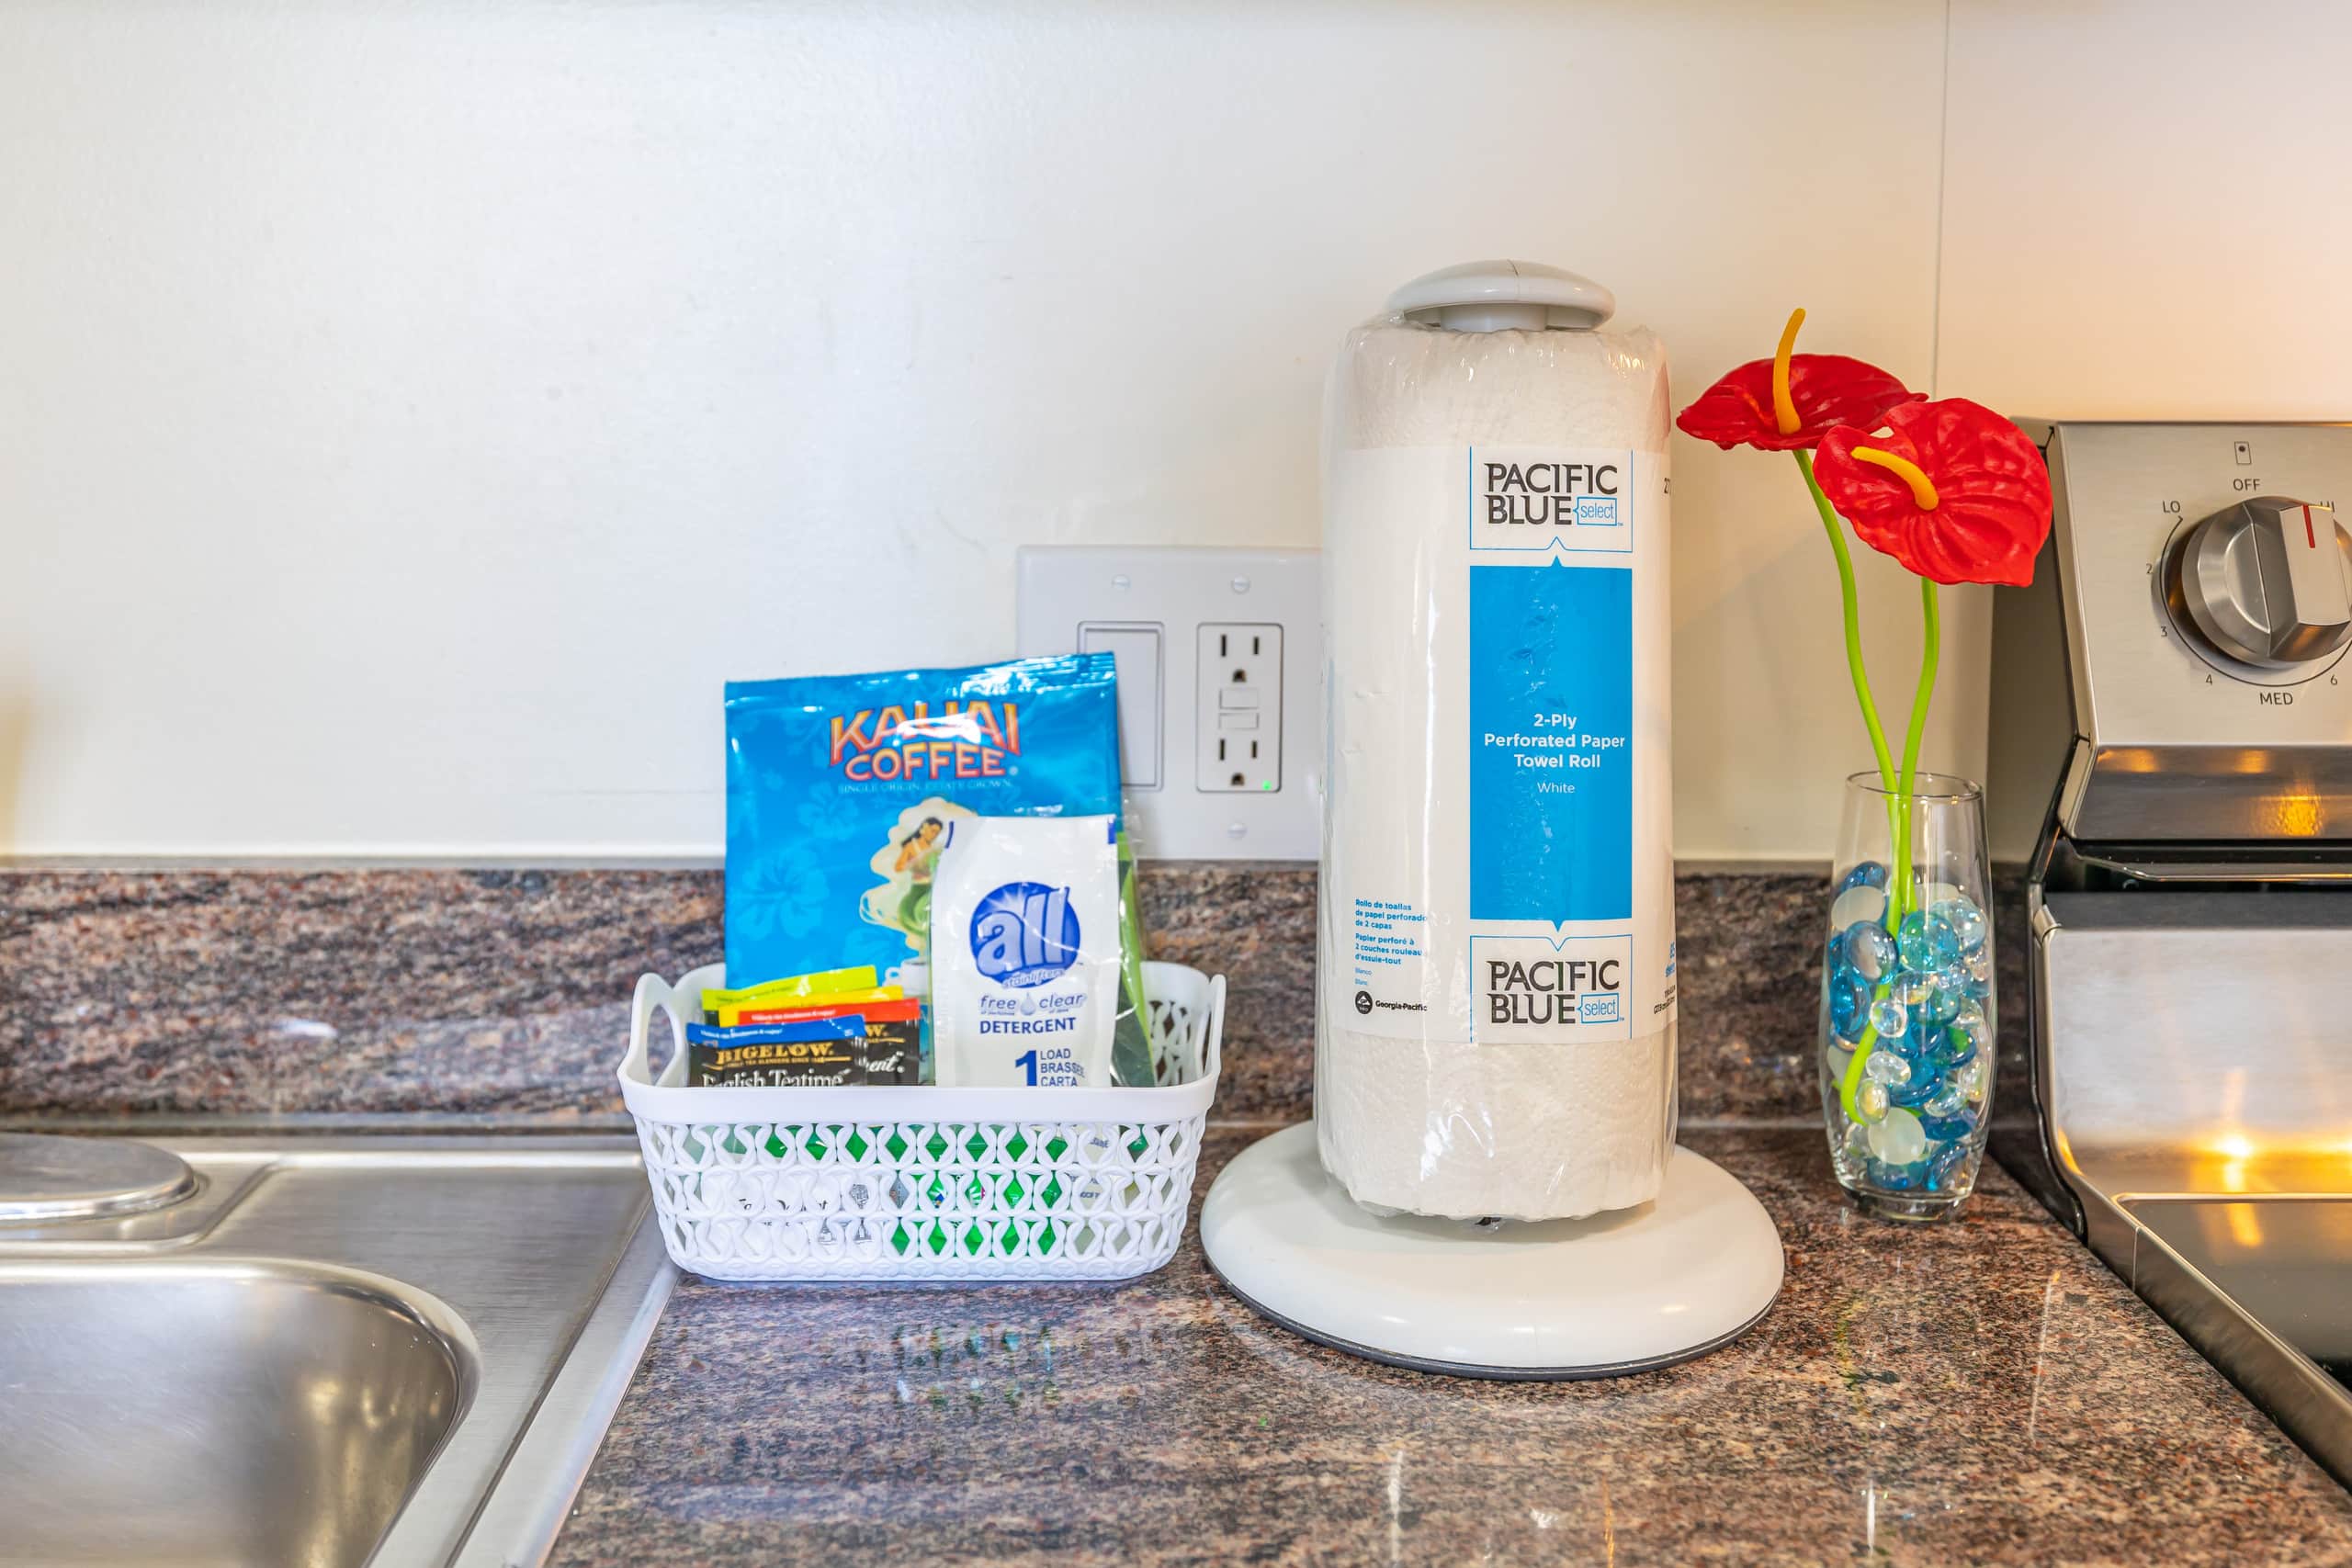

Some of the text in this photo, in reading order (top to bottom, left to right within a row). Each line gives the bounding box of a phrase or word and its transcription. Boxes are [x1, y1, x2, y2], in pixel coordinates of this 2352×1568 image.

[1484, 463, 1618, 494] PACIFIC
[2233, 479, 2260, 491] OFF
[1484, 494, 1614, 525] BLUE select
[2162, 501, 2181, 513] LO
[2146, 563, 2154, 575] 2
[2160, 626, 2168, 637] 3
[2205, 674, 2213, 685] 4
[2330, 675, 2338, 686] 6
[2259, 692, 2294, 705] MED
[1533, 713, 1577, 730] 2-Ply
[830, 700, 1022, 766] KAUAI
[1484, 733, 1625, 750] Perforated Paper
[844, 741, 1006, 781] COFFEE
[1514, 753, 1600, 768] Towel Roll
[1536, 782, 1576, 794] White
[1355, 899, 1372, 908] Rollo
[1374, 900, 1383, 908] de
[1364, 910, 1385, 919] papel
[977, 887, 1069, 976] all
[1371, 922, 1393, 931] capas
[1355, 933, 1376, 942] Papier
[1361, 945, 1389, 953] couches
[1486, 959, 1620, 992] PACIFIC
[980, 994, 1084, 1010] free clear
[1487, 993, 1616, 1024] BLUE select
[979, 1017, 1077, 1034] DETERGENT
[1040, 1048, 1071, 1060] LOAD
[1015, 1050, 1037, 1087] 1
[768, 1067, 843, 1088] Teatime
